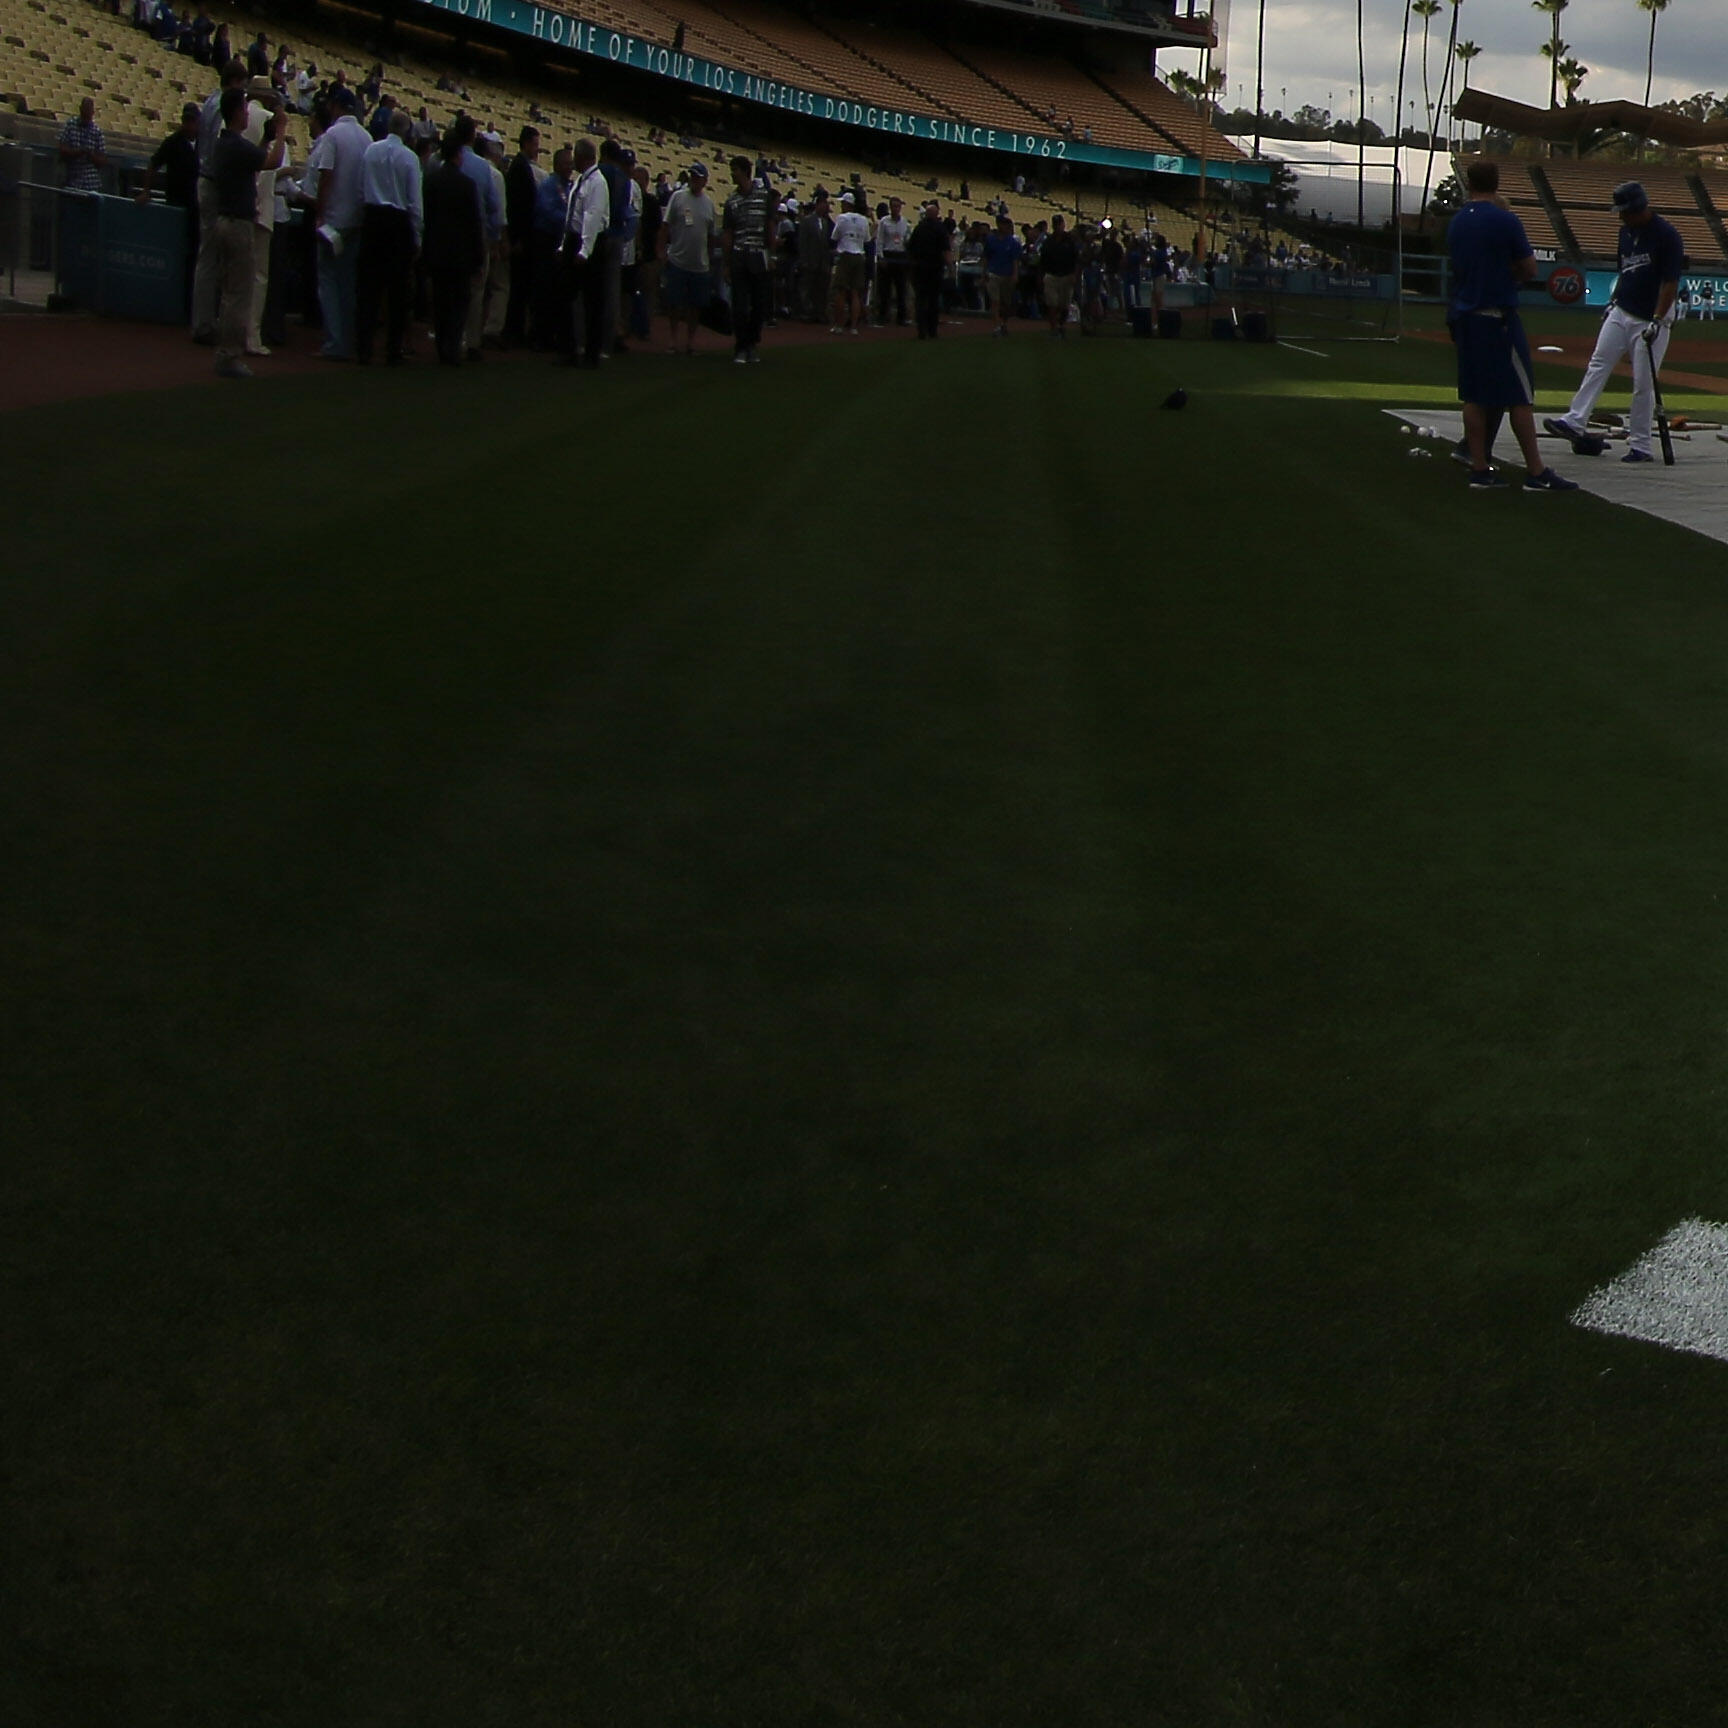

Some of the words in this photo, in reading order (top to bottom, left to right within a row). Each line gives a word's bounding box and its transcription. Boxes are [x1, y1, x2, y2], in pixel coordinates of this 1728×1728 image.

[531, 7, 597, 54] HOME
[609, 33, 635, 62] OF
[646, 43, 695, 89] YOUR
[704, 63, 735, 94] LOS
[743, 75, 815, 115] ANGELES
[825, 97, 916, 137] DODGERS
[929, 119, 996, 149] SINCE
[1011, 134, 1067, 159] 1962
[1552, 276, 1580, 294] 76
